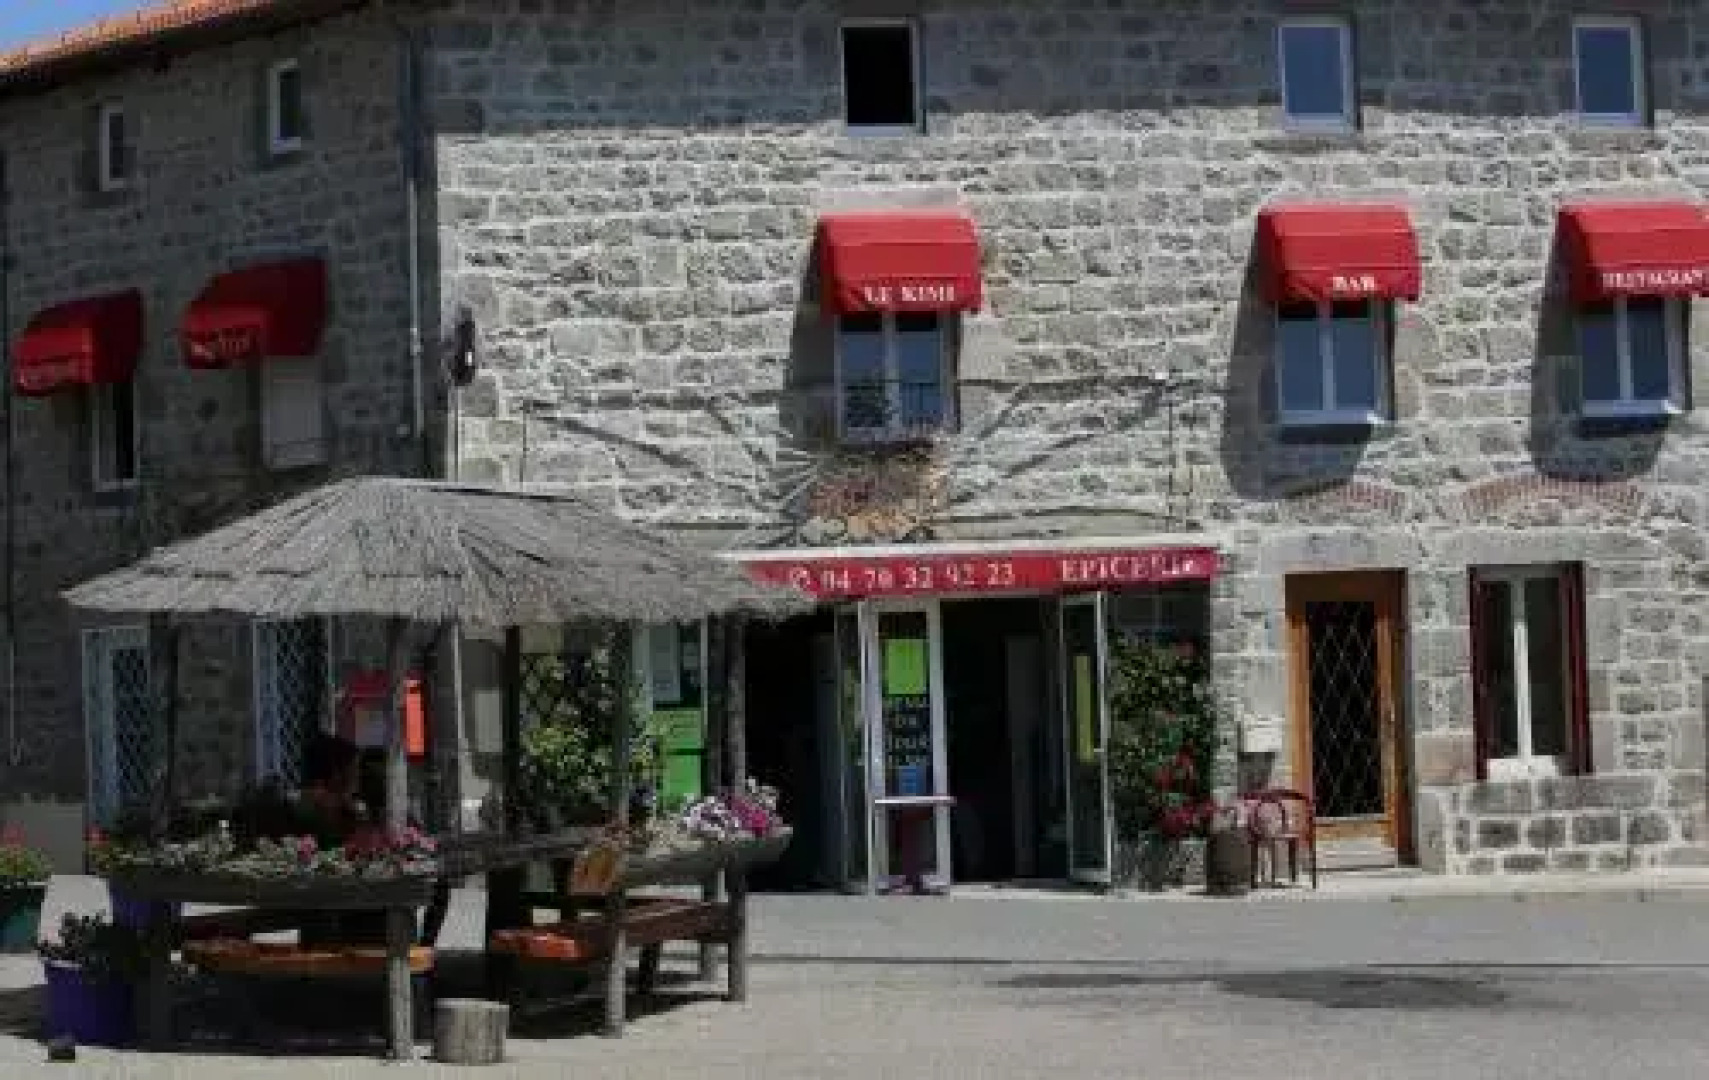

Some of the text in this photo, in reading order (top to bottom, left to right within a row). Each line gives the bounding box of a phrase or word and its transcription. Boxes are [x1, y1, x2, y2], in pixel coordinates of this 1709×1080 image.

[1331, 275, 1375, 292] BAR
[864, 285, 893, 303] LE
[821, 569, 850, 591] 04
[863, 567, 894, 590] 70
[903, 565, 934, 589] 32
[945, 562, 975, 587] 92
[987, 562, 1014, 586] 23
